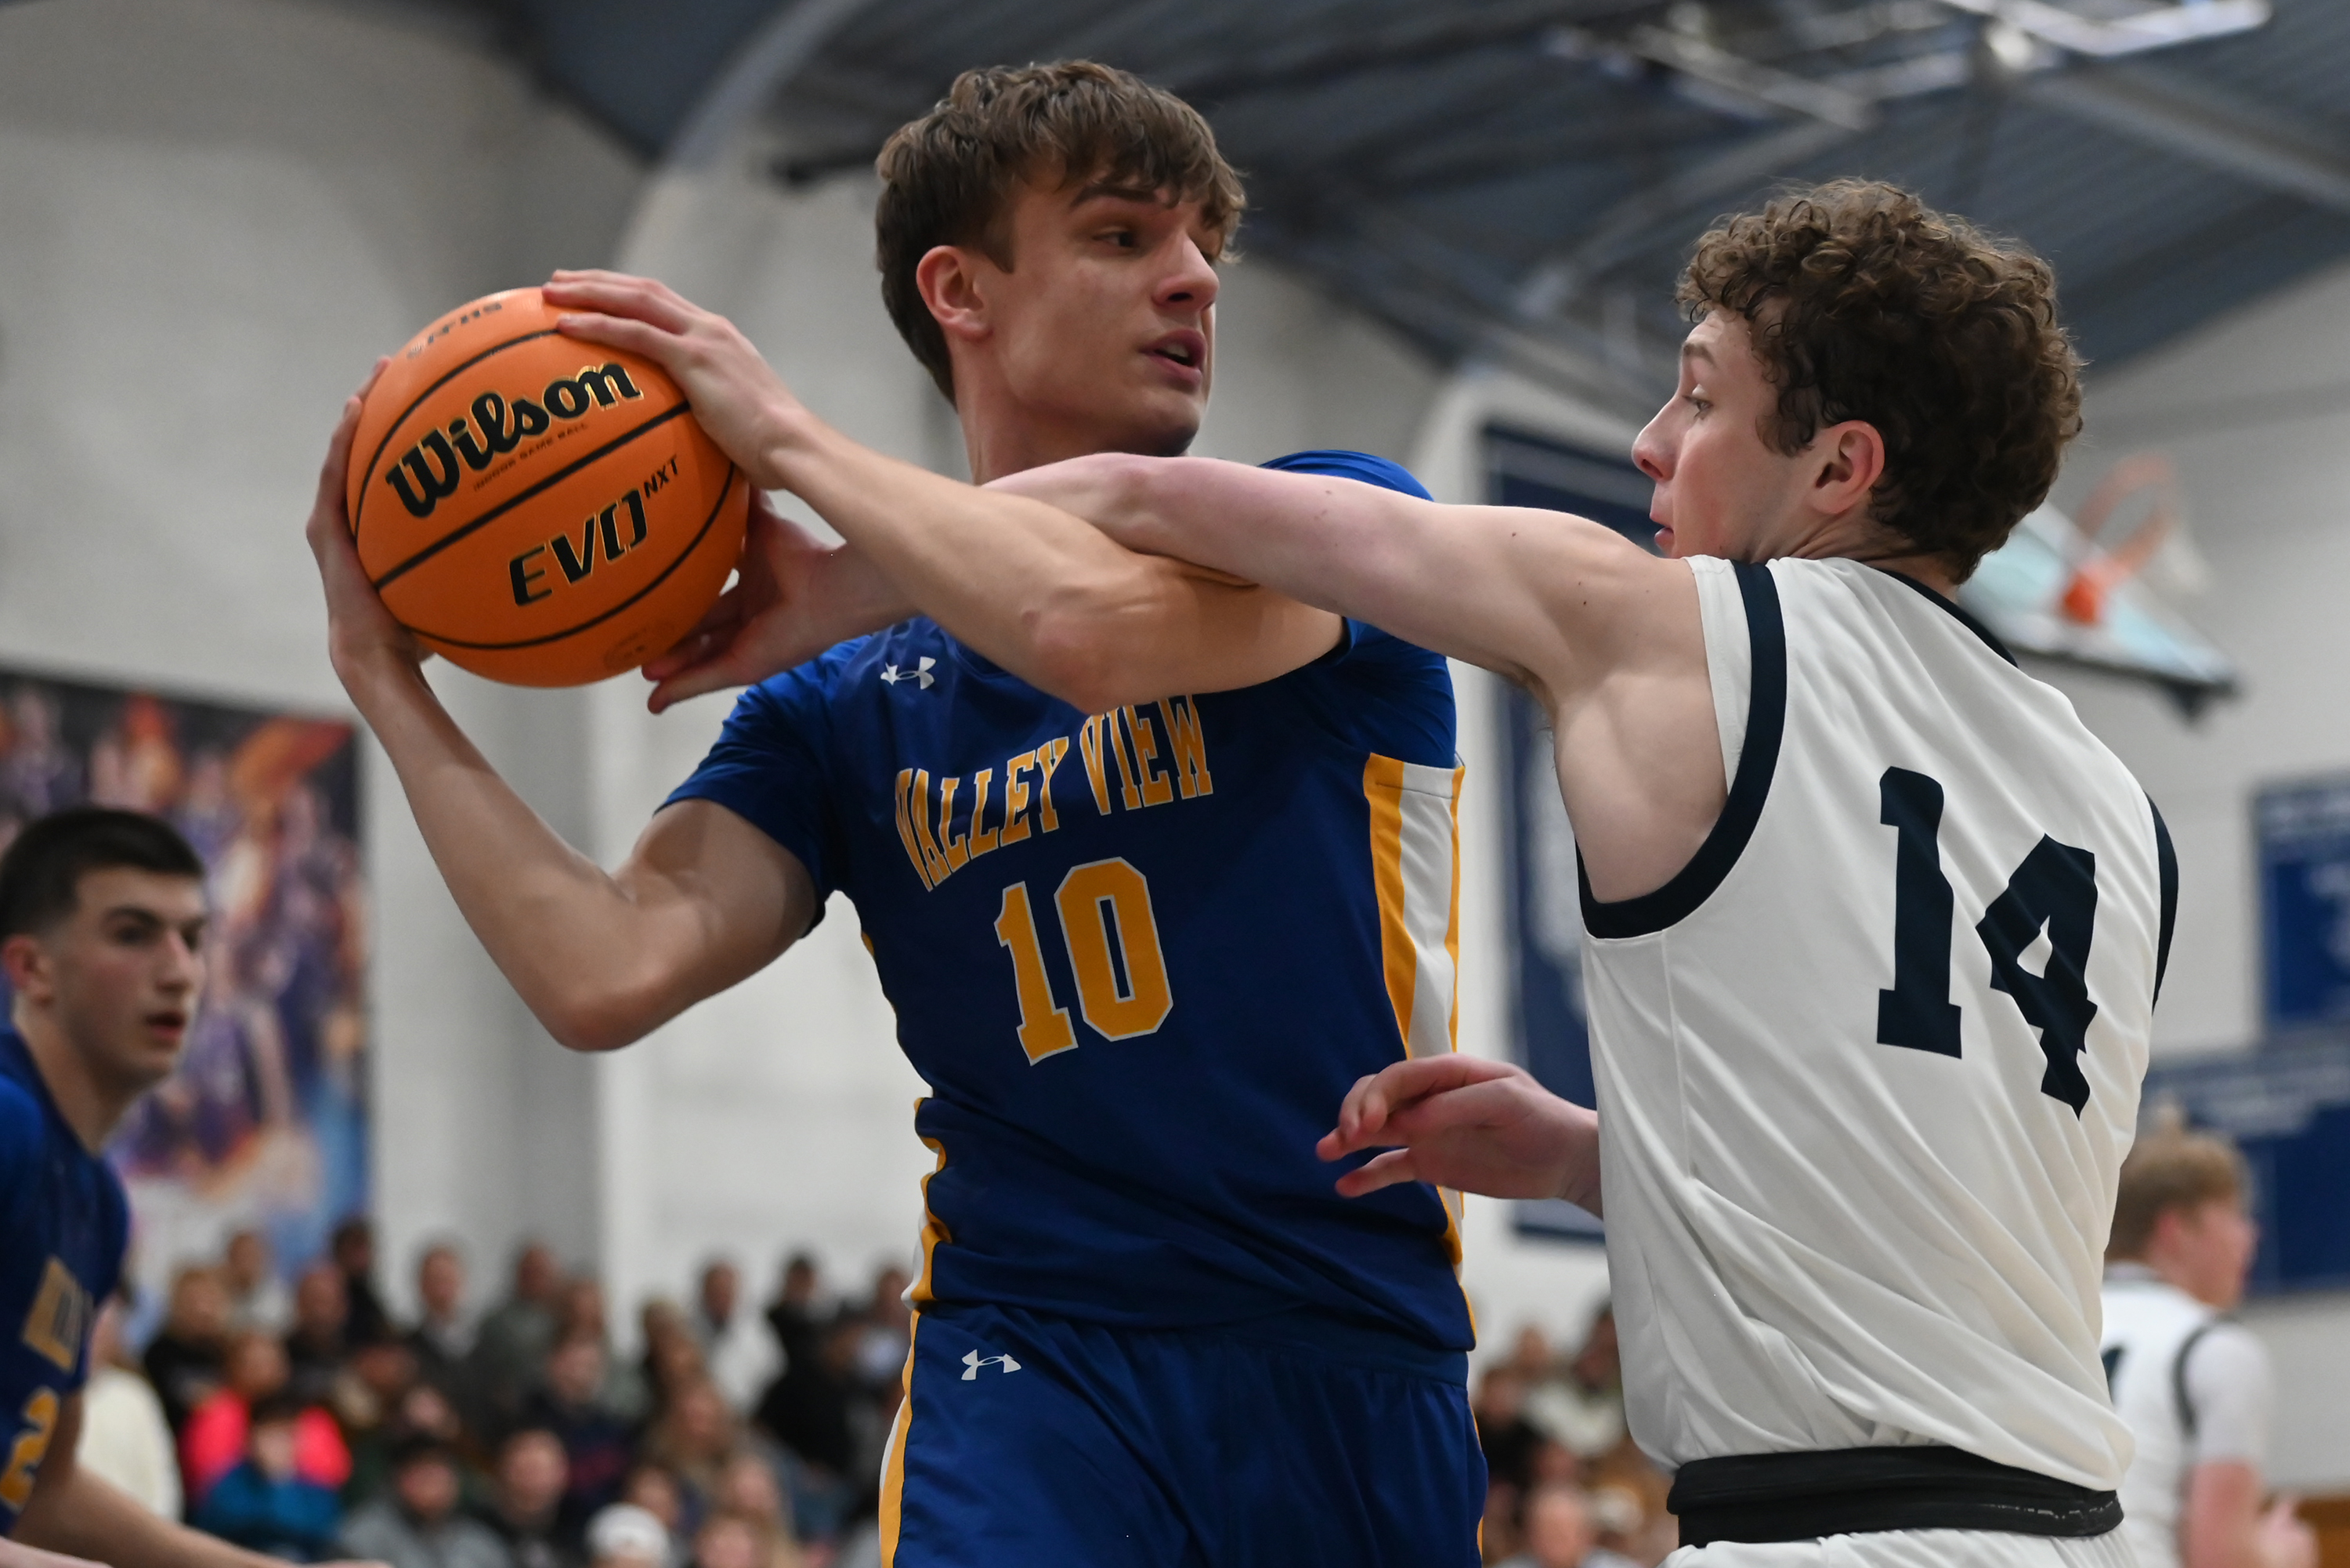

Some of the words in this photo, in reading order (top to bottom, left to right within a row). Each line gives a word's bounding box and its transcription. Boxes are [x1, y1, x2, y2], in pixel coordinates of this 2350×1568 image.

[385, 362, 644, 518] Wilson
[519, 437, 554, 459] GAME
[557, 423, 587, 439] BALL
[509, 487, 648, 606] EVO
[643, 453, 678, 499] NXT
[895, 735, 1069, 892] VALLEY
[1079, 694, 1213, 816] VIEW
[994, 856, 1173, 1066] 10
[1877, 765, 2098, 1122] 14
